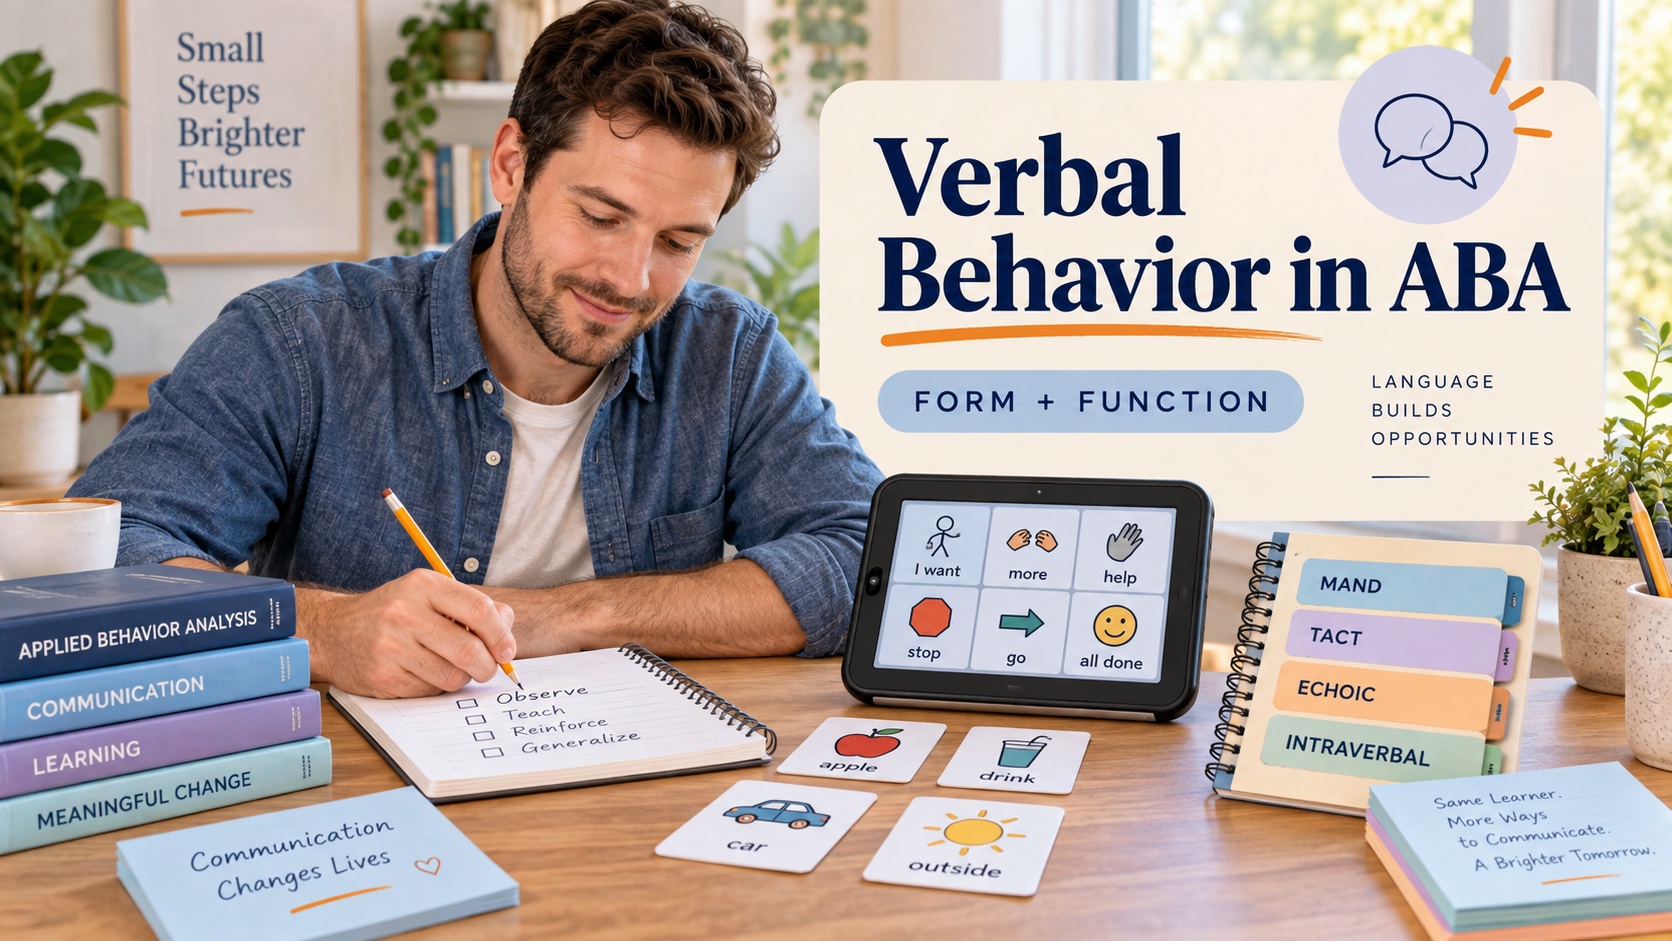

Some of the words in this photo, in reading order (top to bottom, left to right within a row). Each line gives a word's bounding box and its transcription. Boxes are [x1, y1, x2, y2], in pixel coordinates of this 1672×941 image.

[177, 31, 264, 63] Small
[177, 74, 260, 113] Steps
[179, 116, 306, 156] Brighter
[180, 159, 292, 189] Futures
[873, 132, 1187, 217] Verbal
[877, 232, 1271, 313] Behavior
[1289, 235, 1372, 312] in
[1388, 241, 1572, 312] ABA
[1372, 374, 1493, 389] LANGUAGE
[915, 390, 1014, 413] FORM
[1079, 390, 1267, 413] FUNCTION
[1372, 403, 1452, 418] BUILDS
[1371, 431, 1554, 446] OPPORTUNITIES
[914, 563, 920, 575] I
[924, 565, 962, 577] want
[1008, 570, 1048, 581] more
[1103, 569, 1137, 588] help
[1320, 575, 1382, 594] MAND
[18, 634, 93, 660] APPLIED
[97, 621, 181, 648] BEHAVIOR
[184, 609, 257, 635] ANALYSIS
[1310, 627, 1363, 646] TACT
[907, 646, 941, 663] stop
[1006, 653, 1026, 667] go
[1079, 653, 1099, 668] all
[1103, 654, 1143, 670] done
[27, 675, 205, 720] COMMUNICATION
[496, 686, 589, 705] Observe
[1297, 679, 1376, 702] ECHOIC
[502, 705, 566, 721] Teach
[512, 718, 608, 737] Reinforce
[521, 732, 641, 754] Generalize
[1285, 734, 1430, 767] INTRAVERBAL
[33, 740, 141, 775] LEARNING
[819, 759, 878, 775] apple
[979, 769, 1036, 785] drink
[37, 789, 169, 830] MEANINGFUL
[174, 771, 252, 801] CHANGE
[1433, 797, 1484, 810] Same
[1489, 791, 1562, 804] Learner.
[1447, 816, 1494, 829] More
[1498, 810, 1548, 825] Ways
[190, 818, 394, 872] Communication
[726, 840, 768, 852] car
[1458, 836, 1479, 849] to
[1486, 824, 1611, 847] Communicate.
[1475, 858, 1489, 872] A
[1494, 849, 1566, 872] Brighter
[1570, 846, 1656, 863] Tomorrow.
[217, 866, 322, 901] Changes
[331, 850, 391, 875] Lives
[908, 862, 1002, 878] outside
